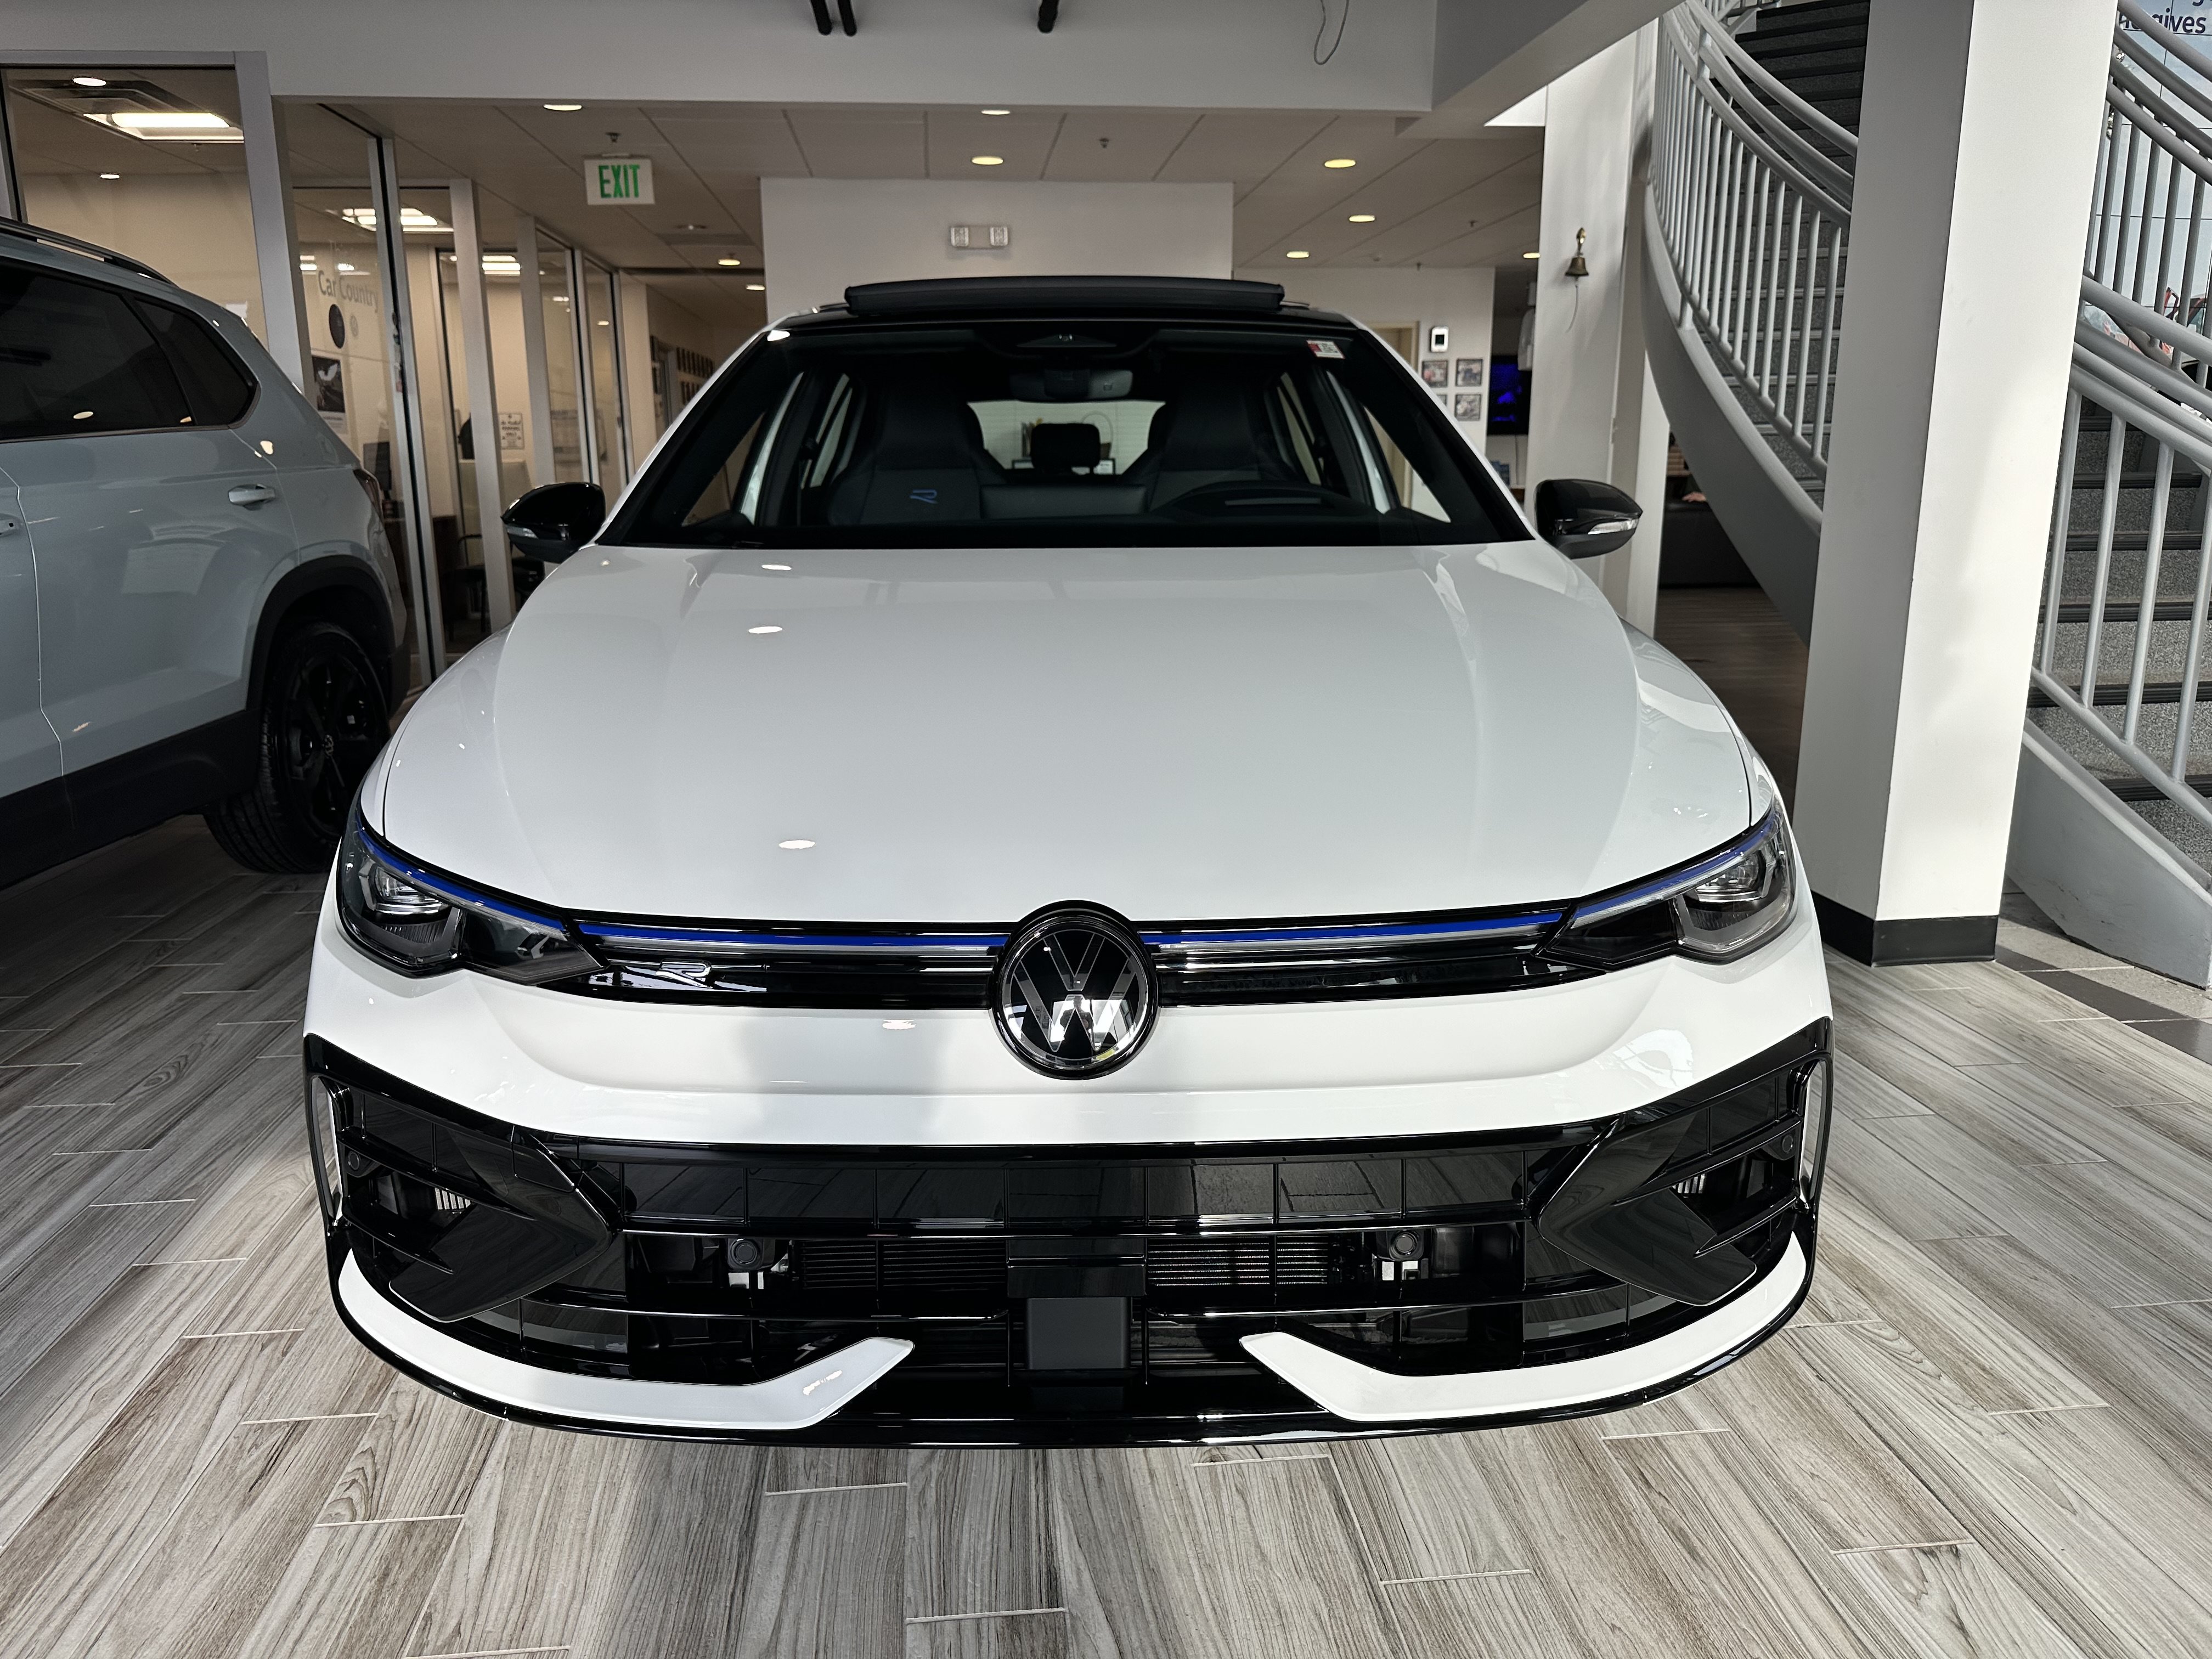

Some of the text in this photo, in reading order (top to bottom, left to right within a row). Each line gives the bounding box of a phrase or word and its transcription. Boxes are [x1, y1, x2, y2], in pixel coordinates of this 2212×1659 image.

[599, 165, 640, 198] EXIT
[318, 270, 378, 313] Car Country
[909, 489, 938, 504] R
[656, 961, 713, 989] R
